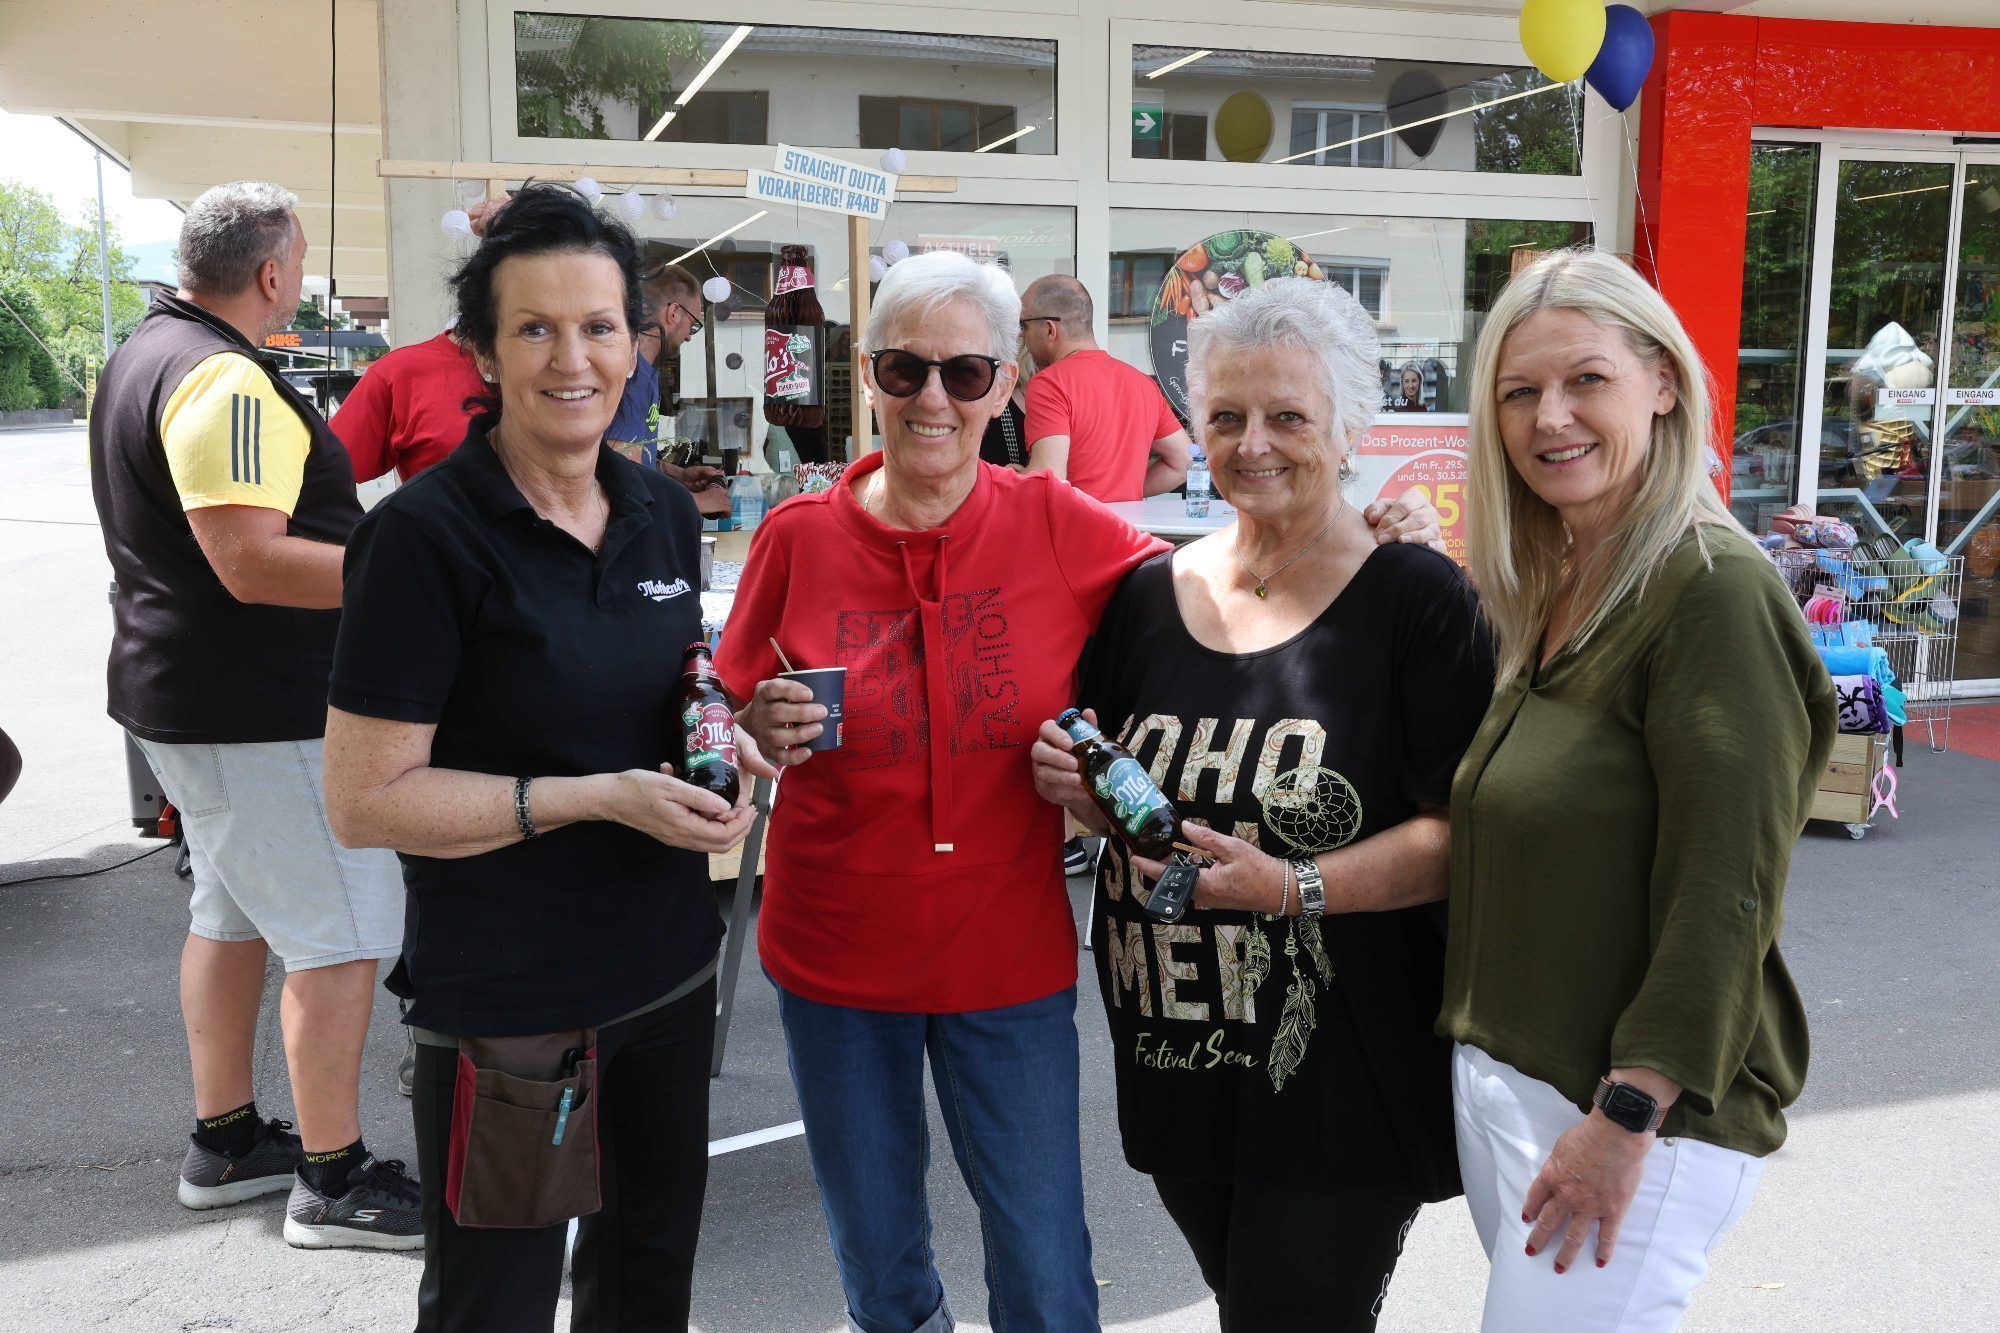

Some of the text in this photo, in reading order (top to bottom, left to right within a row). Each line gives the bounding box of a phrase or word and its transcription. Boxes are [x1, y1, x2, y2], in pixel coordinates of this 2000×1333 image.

[784, 150, 887, 196] STRAIGHT OUTTA
[757, 174, 880, 214] VORARLBERG! #4AB
[923, 240, 995, 257] AKTUELL
[1394, 397, 1408, 407] du
[1888, 390, 1926, 399] EINGANG
[1956, 390, 1994, 399] EINGANG
[1361, 435, 1388, 448] Das
[1412, 461, 1428, 470] Am
[1397, 472, 1415, 481] und
[972, 587, 1021, 750] FASHION
[1135, 1032, 1201, 1070] Festival
[203, 1107, 250, 1130] WORK
[305, 1149, 349, 1164] WORK
